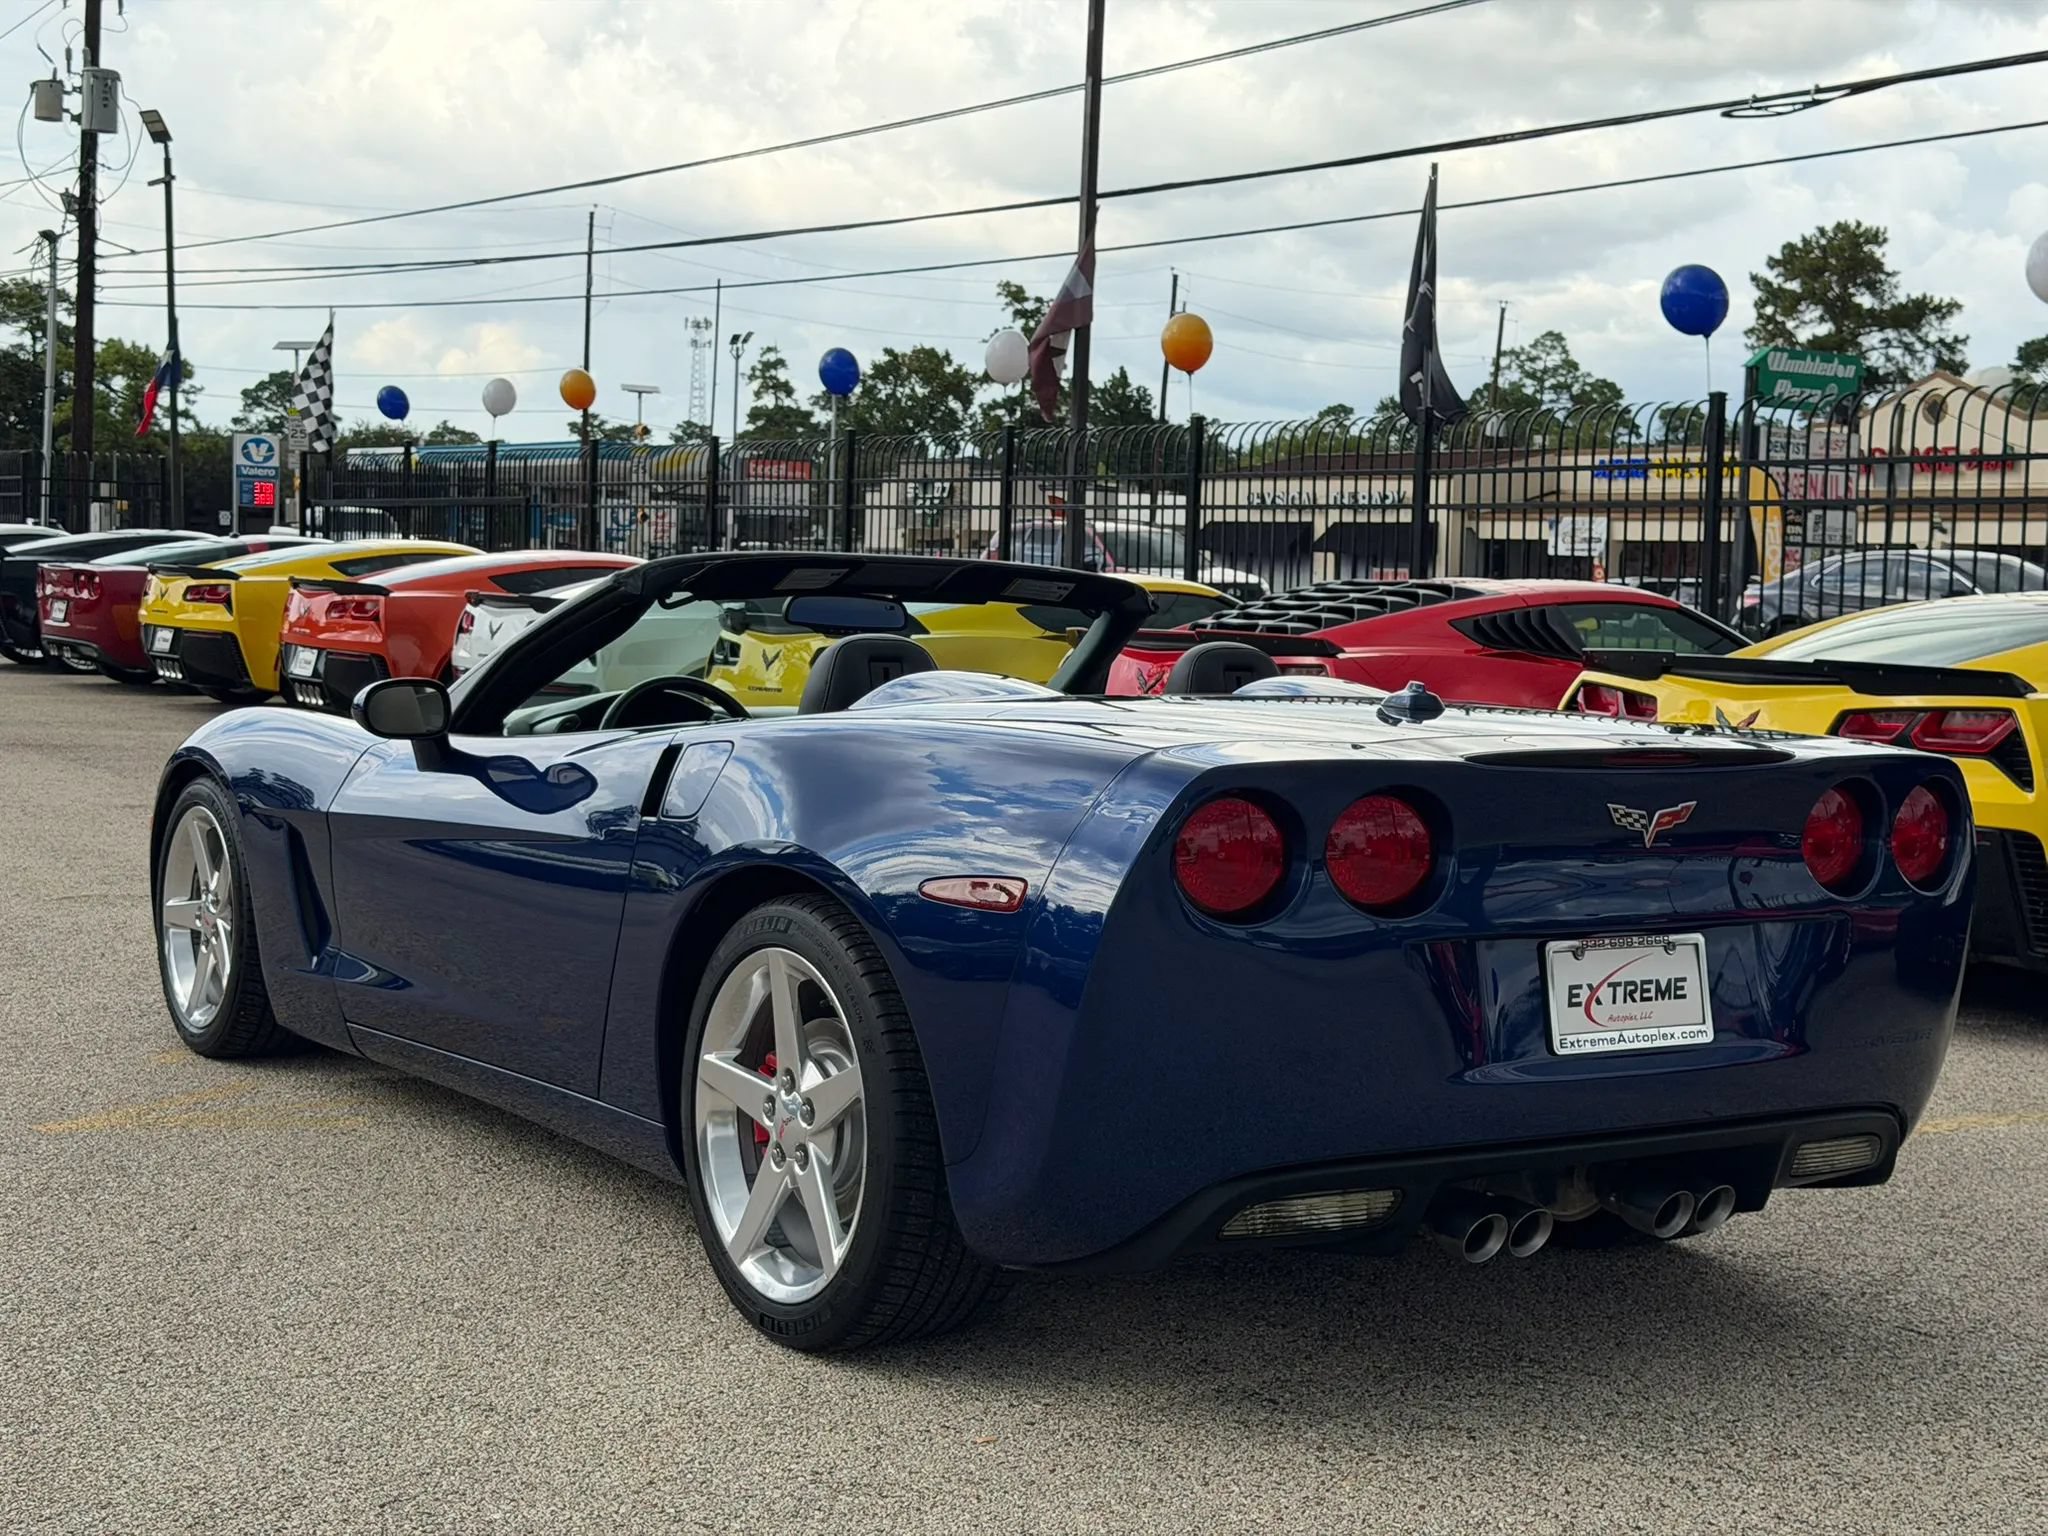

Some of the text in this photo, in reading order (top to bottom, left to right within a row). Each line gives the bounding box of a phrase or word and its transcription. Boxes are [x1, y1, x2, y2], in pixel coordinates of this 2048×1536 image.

[1767, 351, 1856, 378] Wimbledon
[291, 429, 307, 438] 25
[240, 466, 276, 476] Valero
[1567, 977, 1687, 1008] EXTREME
[1640, 1011, 1654, 1020] LLC
[1559, 1029, 1708, 1049] ExtremeAutoplex.com
